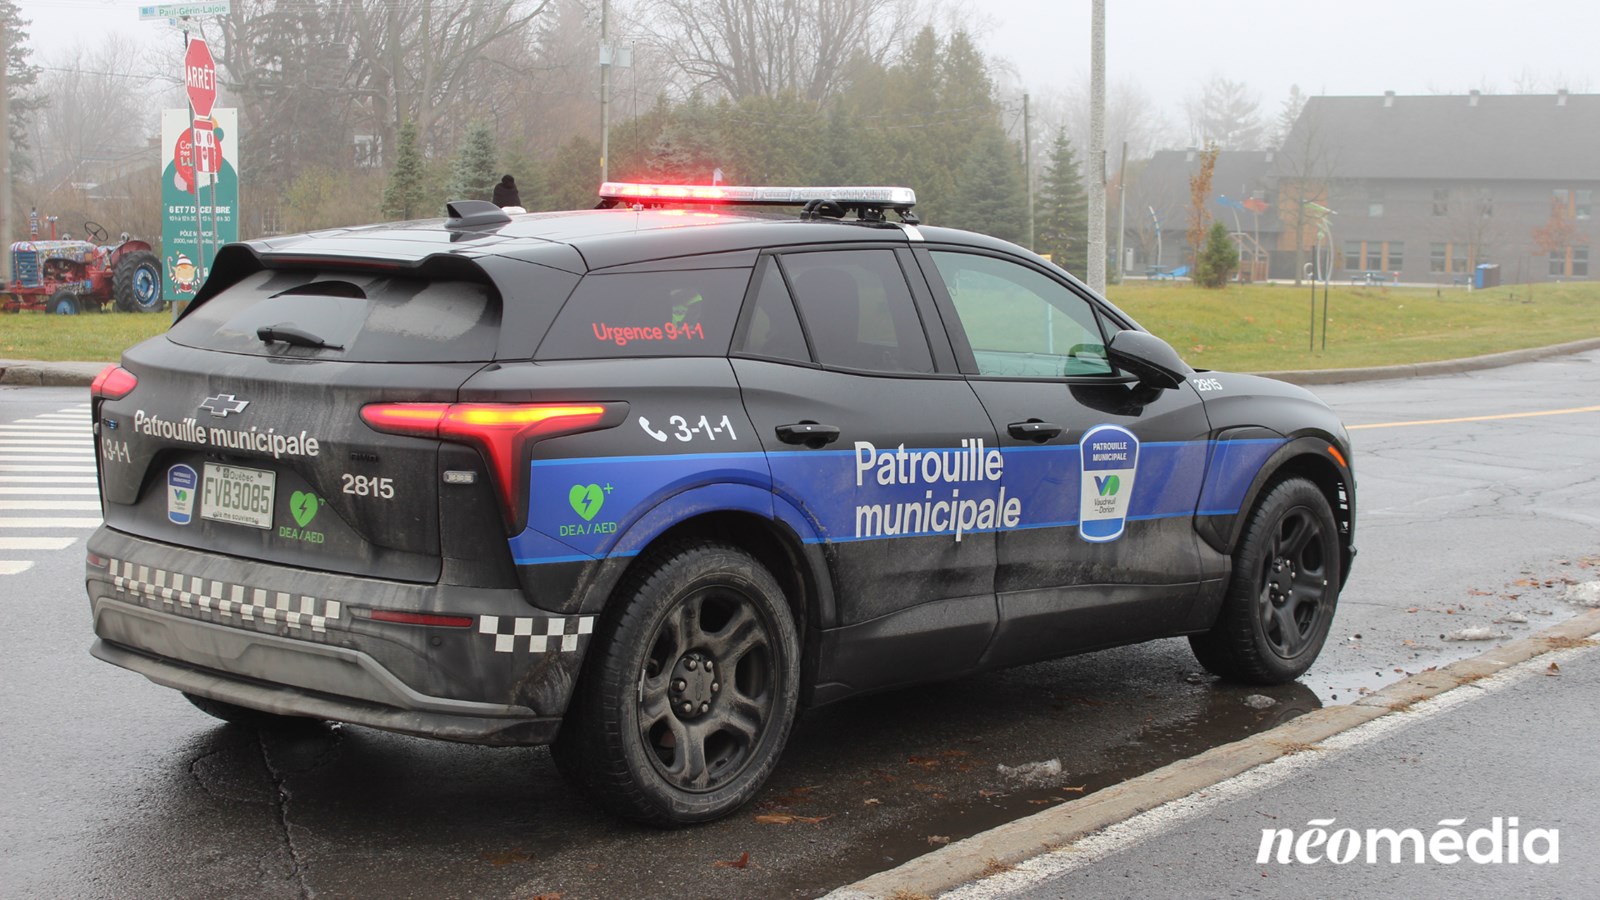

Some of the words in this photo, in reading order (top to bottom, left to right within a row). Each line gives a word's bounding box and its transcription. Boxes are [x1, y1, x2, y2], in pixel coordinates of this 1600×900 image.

[159, 5, 226, 16] Paul-Gérin-Lajoie
[187, 64, 214, 90] ARRÊT
[169, 206, 174, 214] 6
[175, 206, 184, 214] ET
[185, 206, 190, 214] 7
[191, 206, 231, 214] DCEBRE
[592, 322, 663, 346] Urgence
[664, 322, 704, 339] 9-1-1
[1193, 378, 1223, 391] 2815
[134, 409, 207, 444] Patrouille
[210, 426, 320, 459] municipale
[669, 415, 737, 442] 3-1-1
[106, 438, 131, 463] 3-1-1
[1092, 442, 1127, 450] PATROUILLE
[1092, 453, 1127, 461] MUNICIPALE
[854, 438, 1004, 486] Patrouille
[230, 471, 254, 482] Québec
[342, 473, 395, 499] 2815
[204, 477, 271, 514] FVB3085
[855, 486, 1021, 542] municipale
